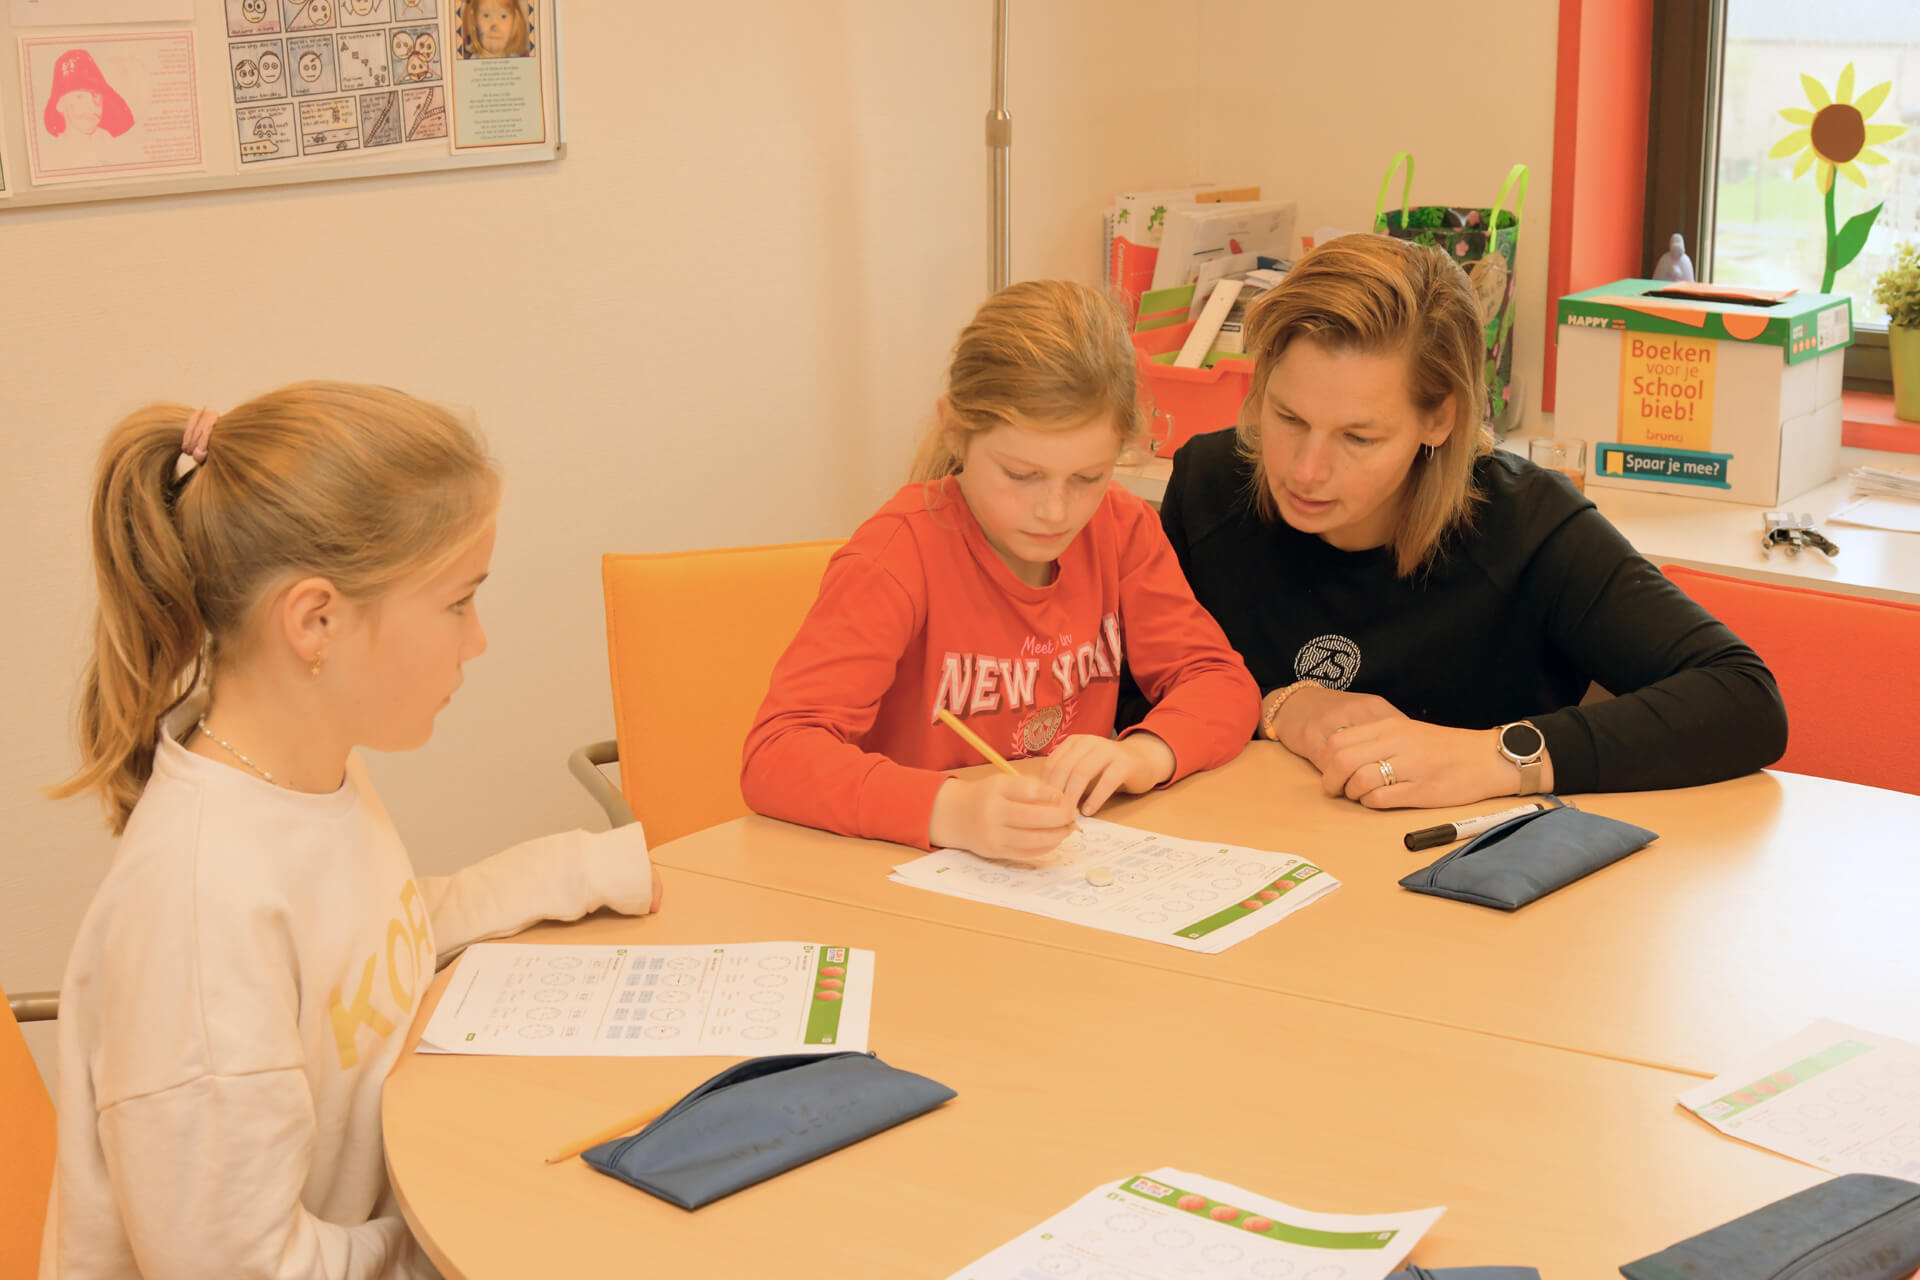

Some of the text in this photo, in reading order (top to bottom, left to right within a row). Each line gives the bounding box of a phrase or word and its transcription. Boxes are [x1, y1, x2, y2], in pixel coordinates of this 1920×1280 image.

[1567, 314, 1609, 328] HAPPY
[1631, 339, 1711, 363] Boeken
[1646, 362, 1699, 382] voor je
[1633, 376, 1703, 400] School
[1641, 397, 1694, 421] bieb!
[1626, 454, 1720, 476] Spaar je mee?
[1020, 634, 1054, 657] Meet
[932, 651, 1040, 724] NEW
